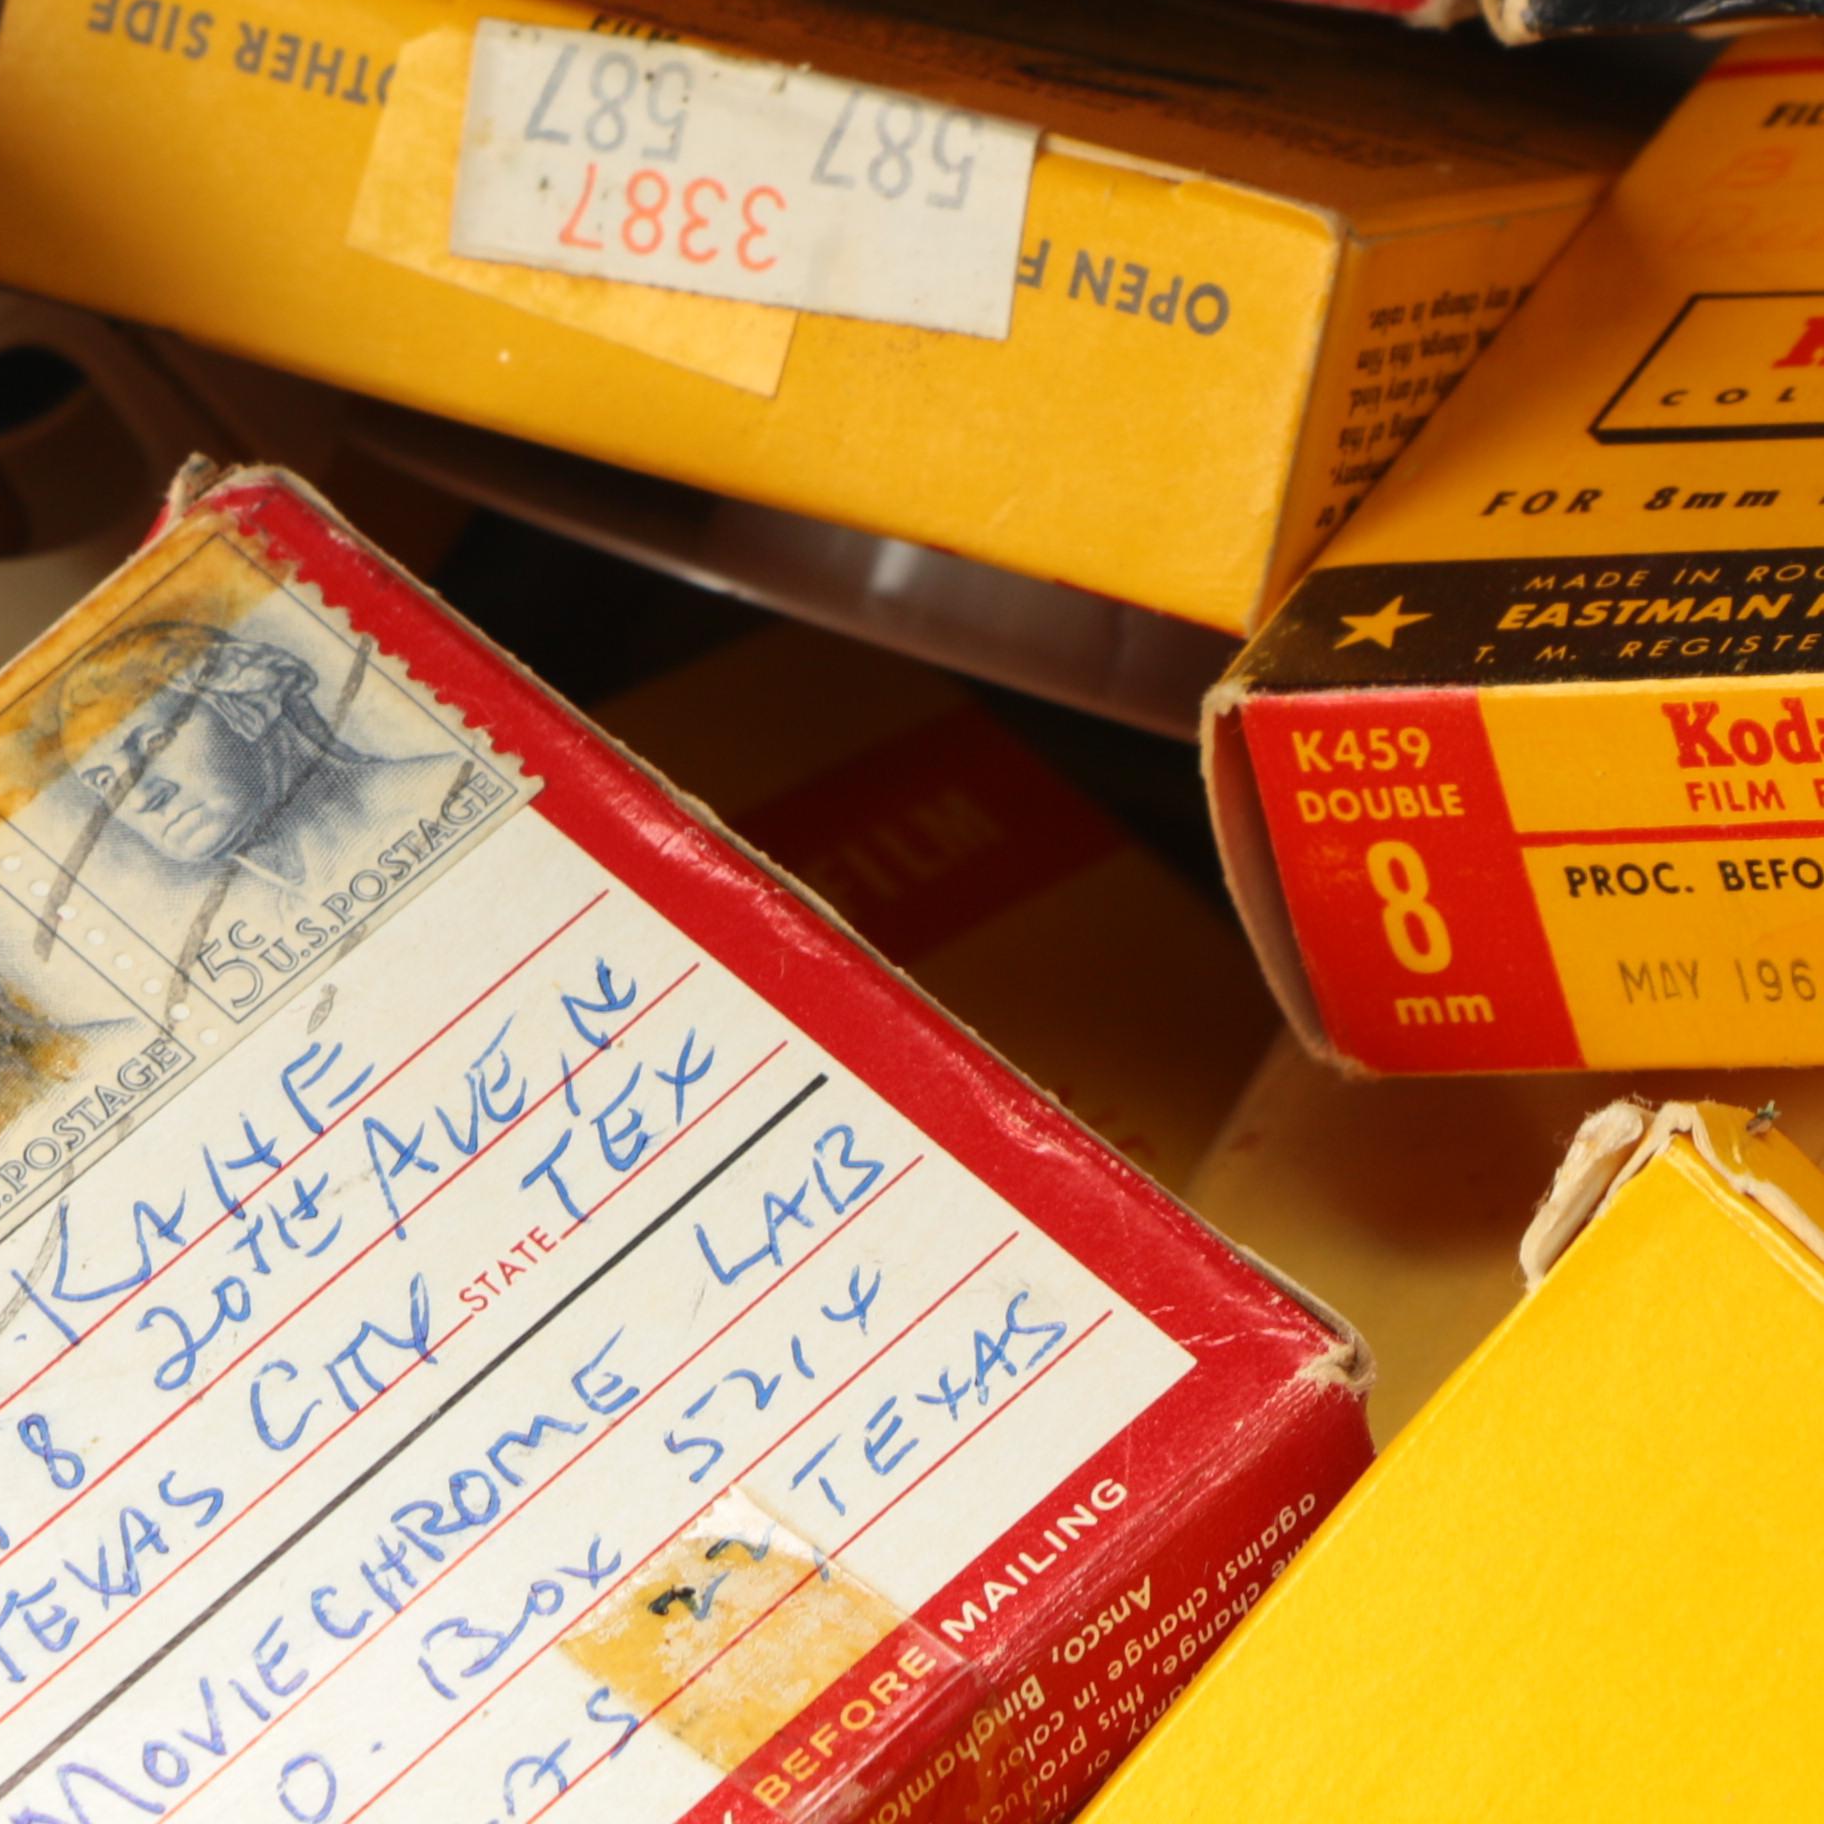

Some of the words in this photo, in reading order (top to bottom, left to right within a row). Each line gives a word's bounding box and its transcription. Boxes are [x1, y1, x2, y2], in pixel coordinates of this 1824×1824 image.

[523, 42, 694, 163] 587
[810, 88, 985, 211] 587
[559, 162, 787, 273] 3387
[1068, 248, 1230, 336] OPEN
[1482, 488, 1603, 516] FOR
[1643, 486, 1780, 511] 8mm
[1497, 594, 1792, 630] EASTMAN
[1524, 569, 1648, 590] MADE
[1672, 568, 1720, 585] IN
[1474, 645, 1497, 665] T.
[1535, 645, 1576, 661] M.
[1291, 726, 1431, 772] K459
[1296, 783, 1465, 823] DOUBLE
[1685, 779, 1786, 812] FILM
[1366, 840, 1452, 973] 8
[1564, 861, 1694, 898] PROC.
[1394, 994, 1495, 1024] mm
[1617, 959, 1699, 1004] MAY
[521, 1031, 717, 1220] TEX
[459, 1225, 558, 1312] STATE
[250, 1273, 434, 1451] CITY
[792, 1289, 1067, 1516] TEXAS
[10, 1326, 642, 1824] MOVIECHROME
[694, 1122, 887, 1286] LAB
[417, 1534, 622, 1701] BOX
[663, 1265, 882, 1484] 5214
[1215, 1492, 1315, 1592] against
[751, 1642, 939, 1810] BEFORE
[940, 1478, 1128, 1643] MAILING
[1051, 1574, 1153, 1665] Ansco,
[1106, 1586, 1207, 1680] change
[1072, 1681, 1100, 1710] in
[1098, 1682, 1147, 1733] this
[985, 1709, 1064, 1777] color.
